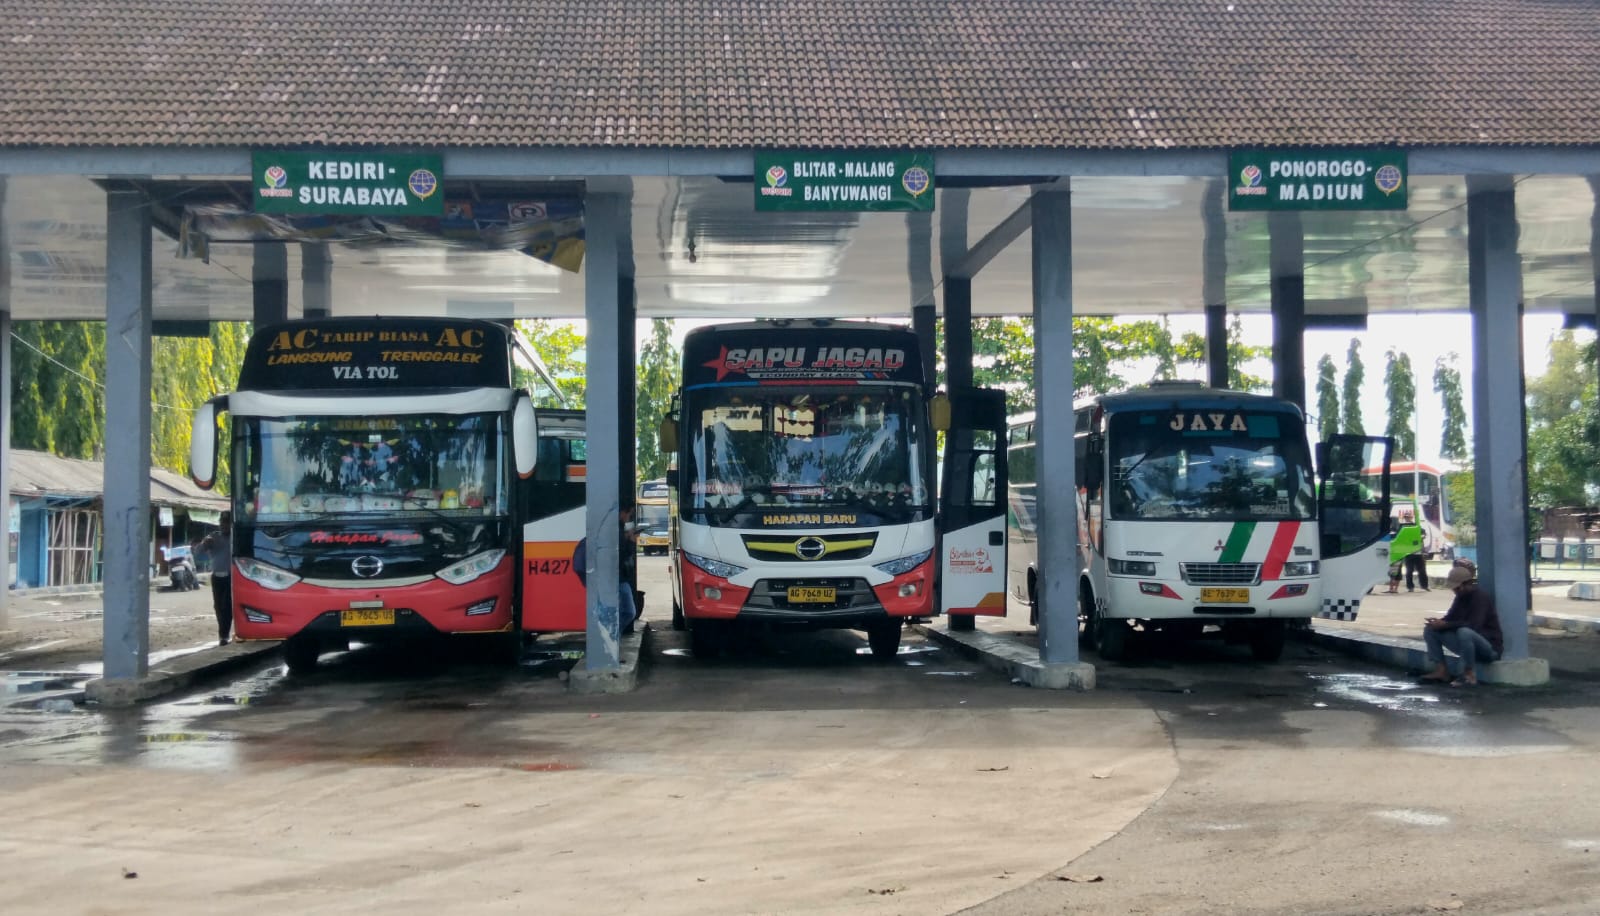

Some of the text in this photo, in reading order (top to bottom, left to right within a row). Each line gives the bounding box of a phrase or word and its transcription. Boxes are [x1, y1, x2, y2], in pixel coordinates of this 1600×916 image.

[298, 186, 408, 206] SURABAYA
[804, 185, 891, 201] BANYUWANGI
[1279, 184, 1363, 201] MADIUN
[267, 328, 484, 351] AC TARIP BIASA AC
[267, 351, 483, 366] LANGSUNG TRENGGALEK
[725, 347, 905, 369] SAPU JAGAD
[332, 366, 399, 379] VIA TOL
[1169, 413, 1248, 431] JAYA
[763, 513, 857, 525] HARAPAN BARU
[310, 530, 378, 544] Harapan
[528, 559, 571, 576] H427
